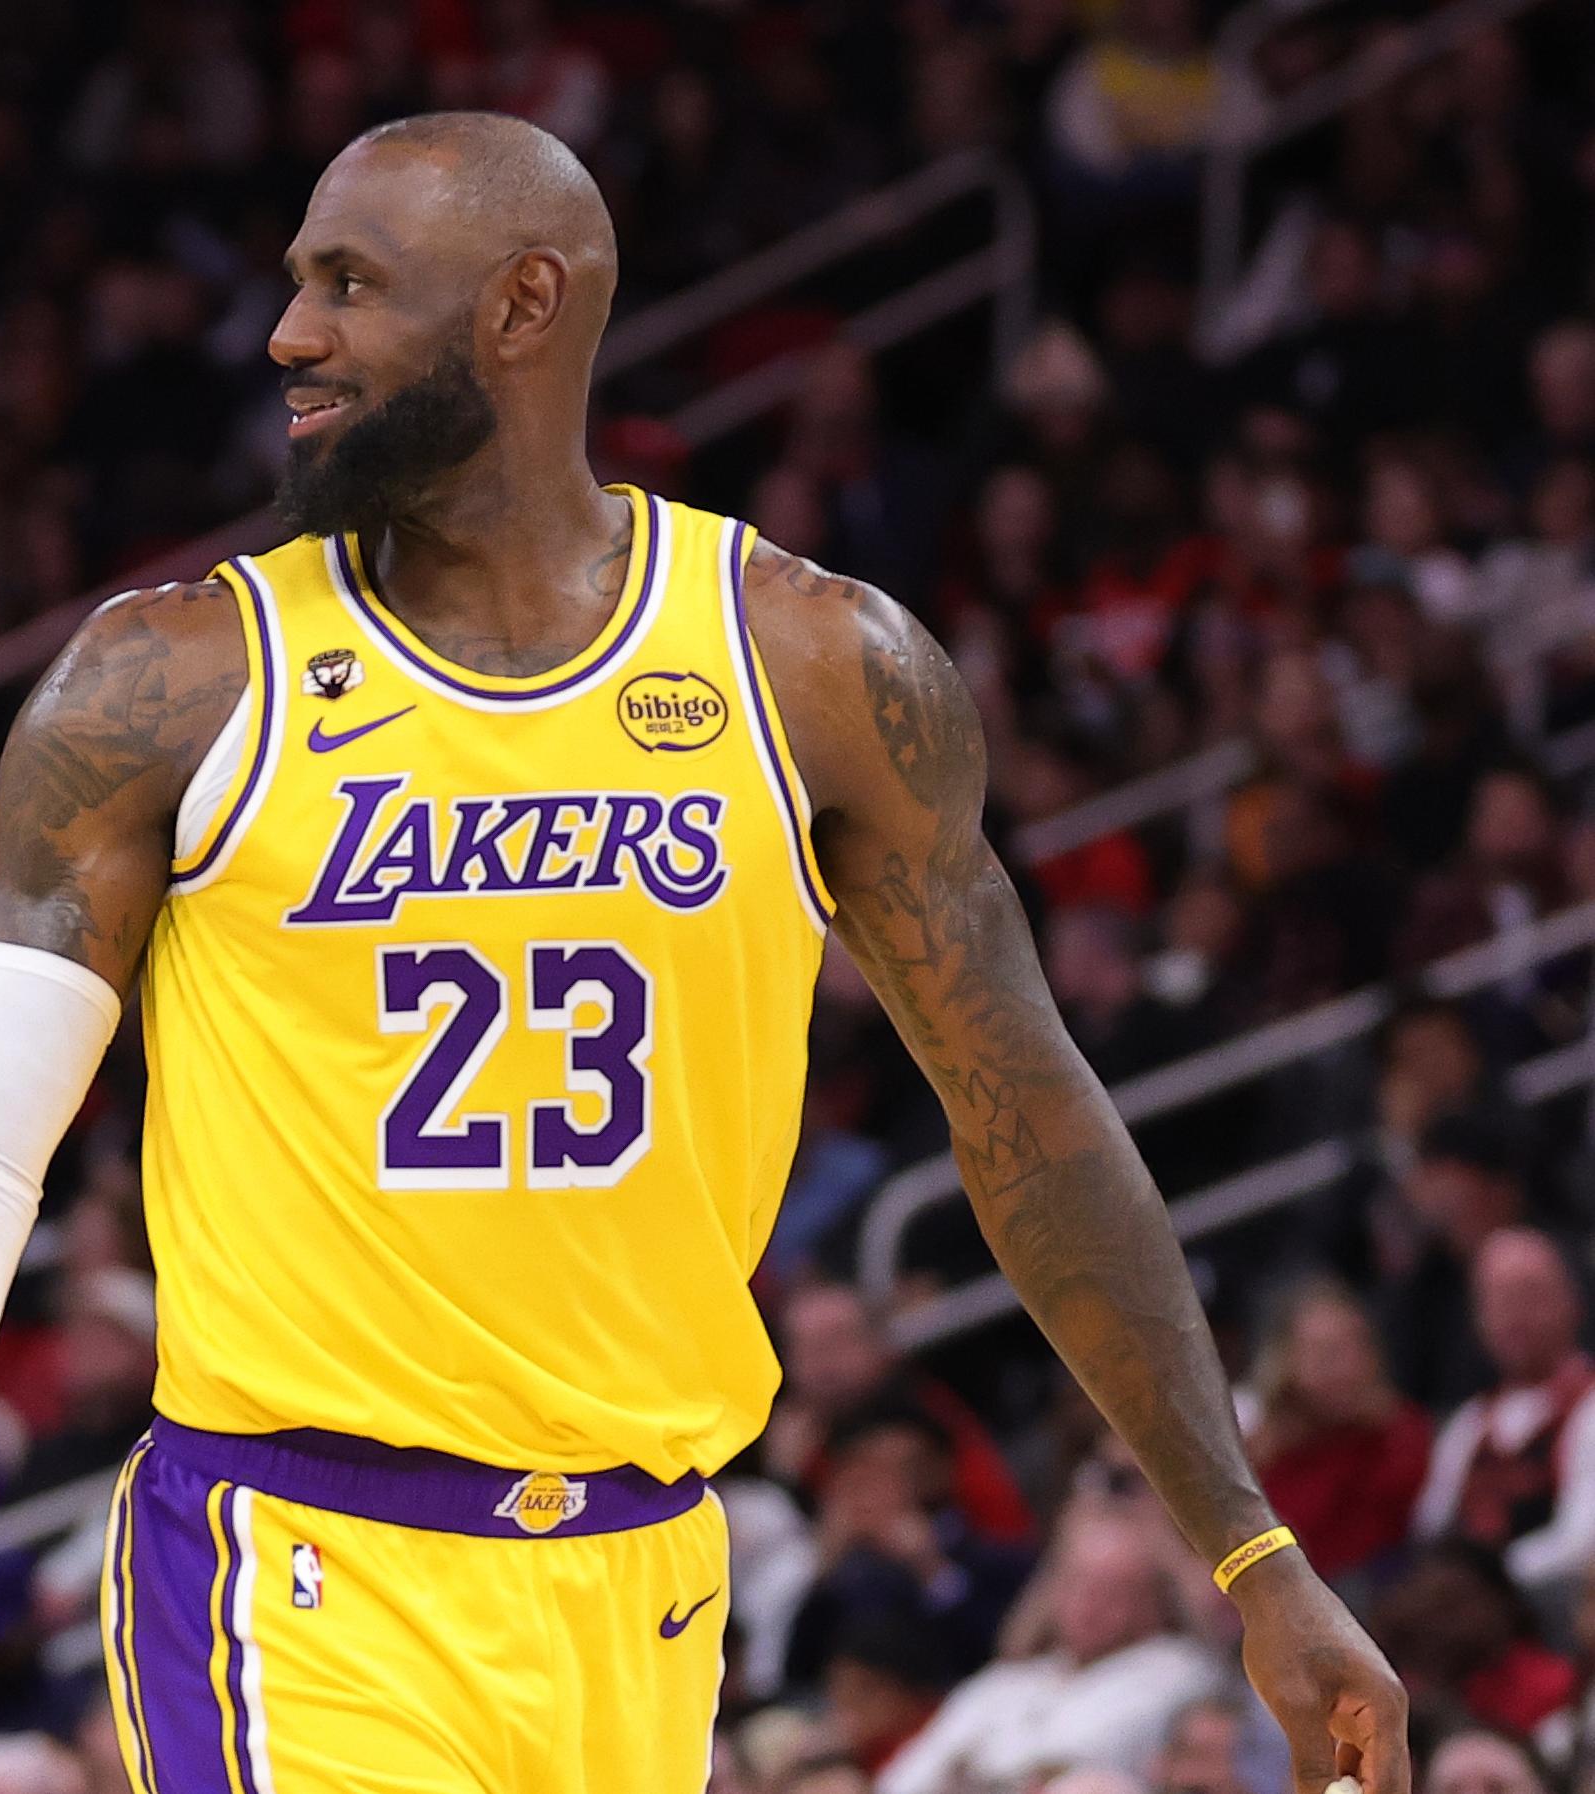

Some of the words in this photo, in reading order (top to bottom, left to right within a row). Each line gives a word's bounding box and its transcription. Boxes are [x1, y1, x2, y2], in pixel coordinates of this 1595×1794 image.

[626, 692, 720, 727] bibigo
[282, 773, 732, 926] LAKERS
[375, 940, 654, 1190] 23
